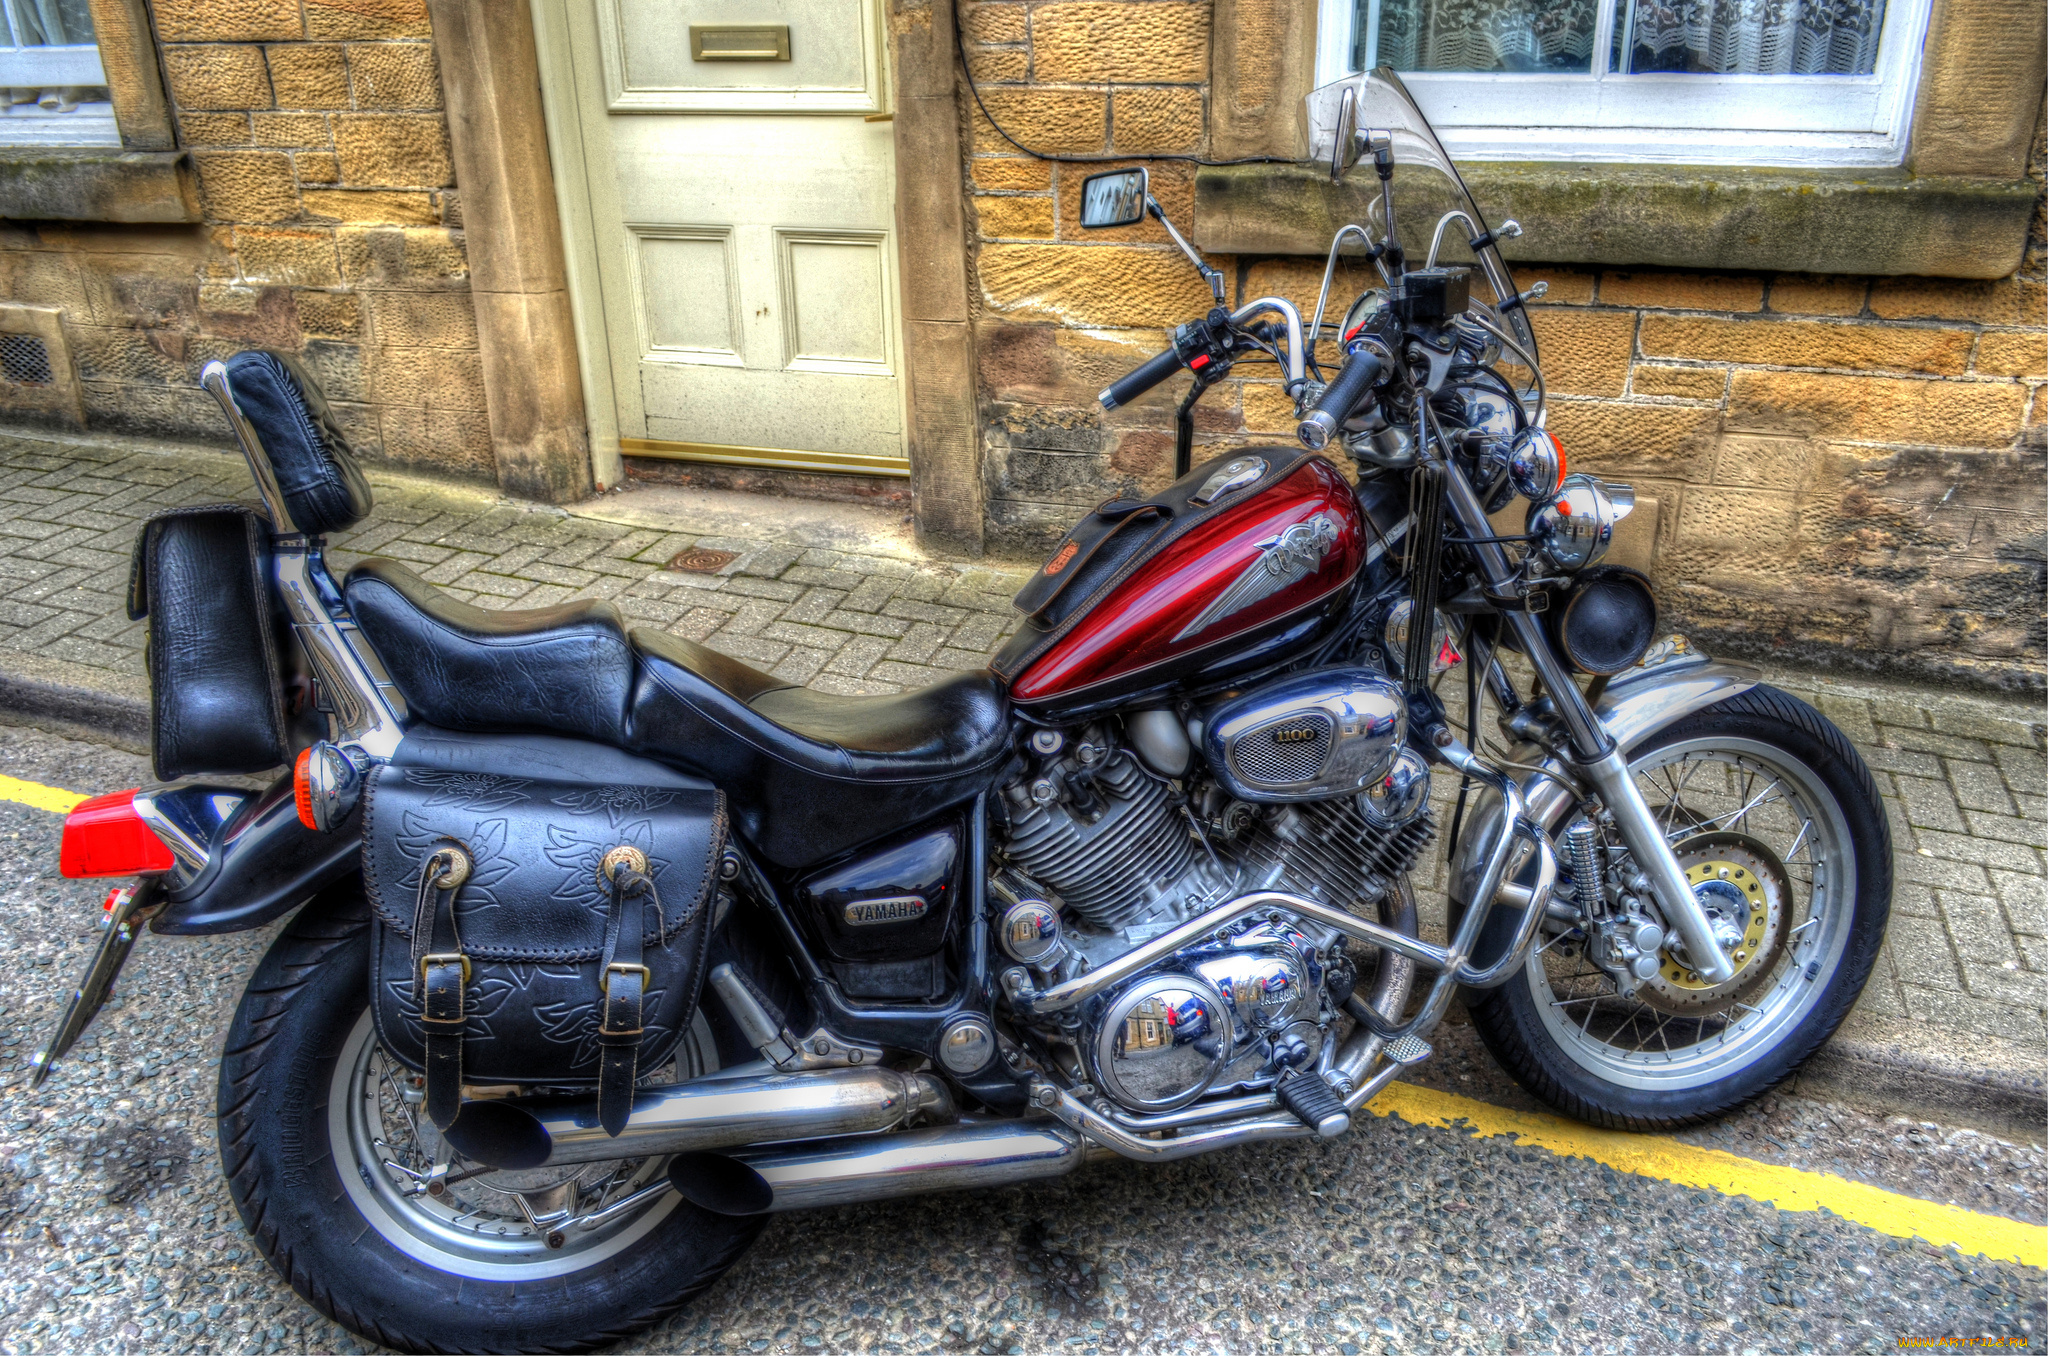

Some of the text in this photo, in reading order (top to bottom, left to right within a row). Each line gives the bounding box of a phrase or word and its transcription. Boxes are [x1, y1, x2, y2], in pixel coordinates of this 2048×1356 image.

[1276, 728, 1315, 742] 1100
[855, 901, 918, 921] YAMAHA
[275, 1026, 324, 1189] BRIDGESTONE
